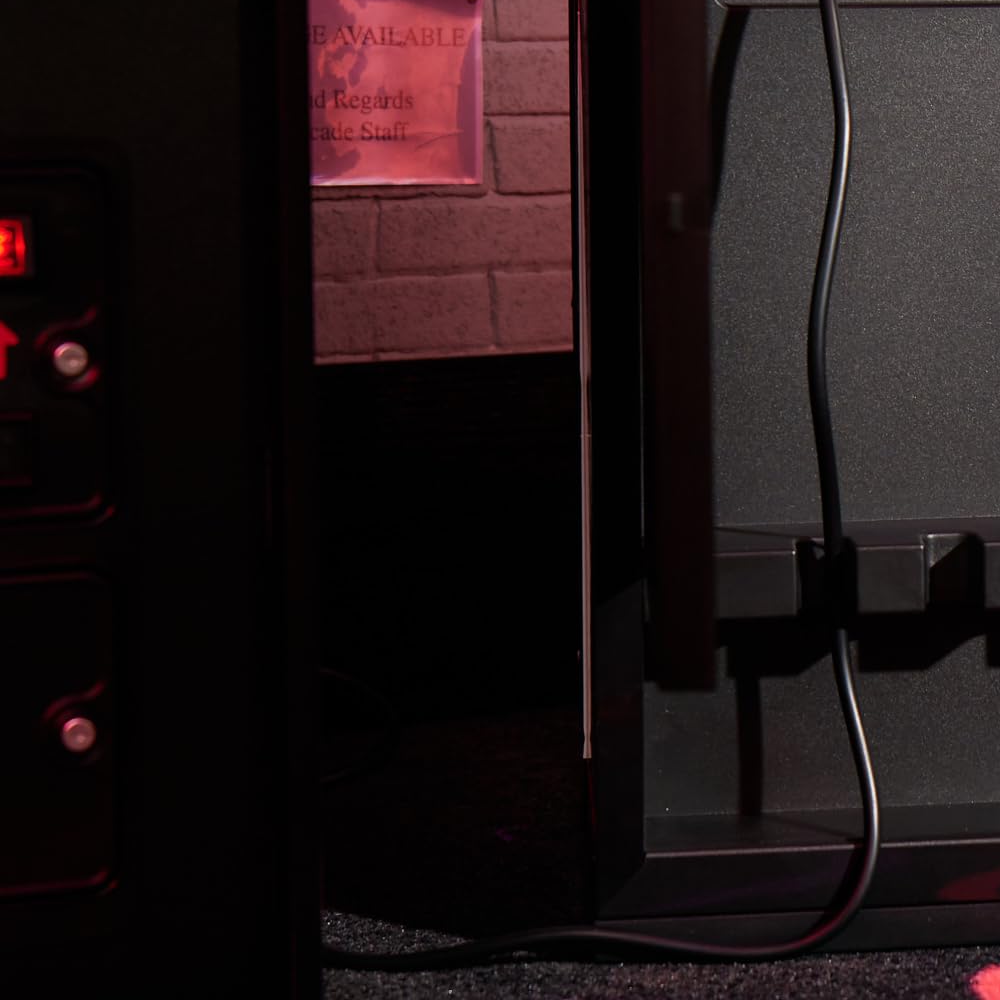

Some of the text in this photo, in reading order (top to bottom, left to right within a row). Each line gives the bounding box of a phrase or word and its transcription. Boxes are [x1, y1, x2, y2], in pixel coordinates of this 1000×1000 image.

[334, 24, 466, 47] AVAILABLE
[334, 89, 415, 115] Regards
[361, 121, 410, 142] Staff
